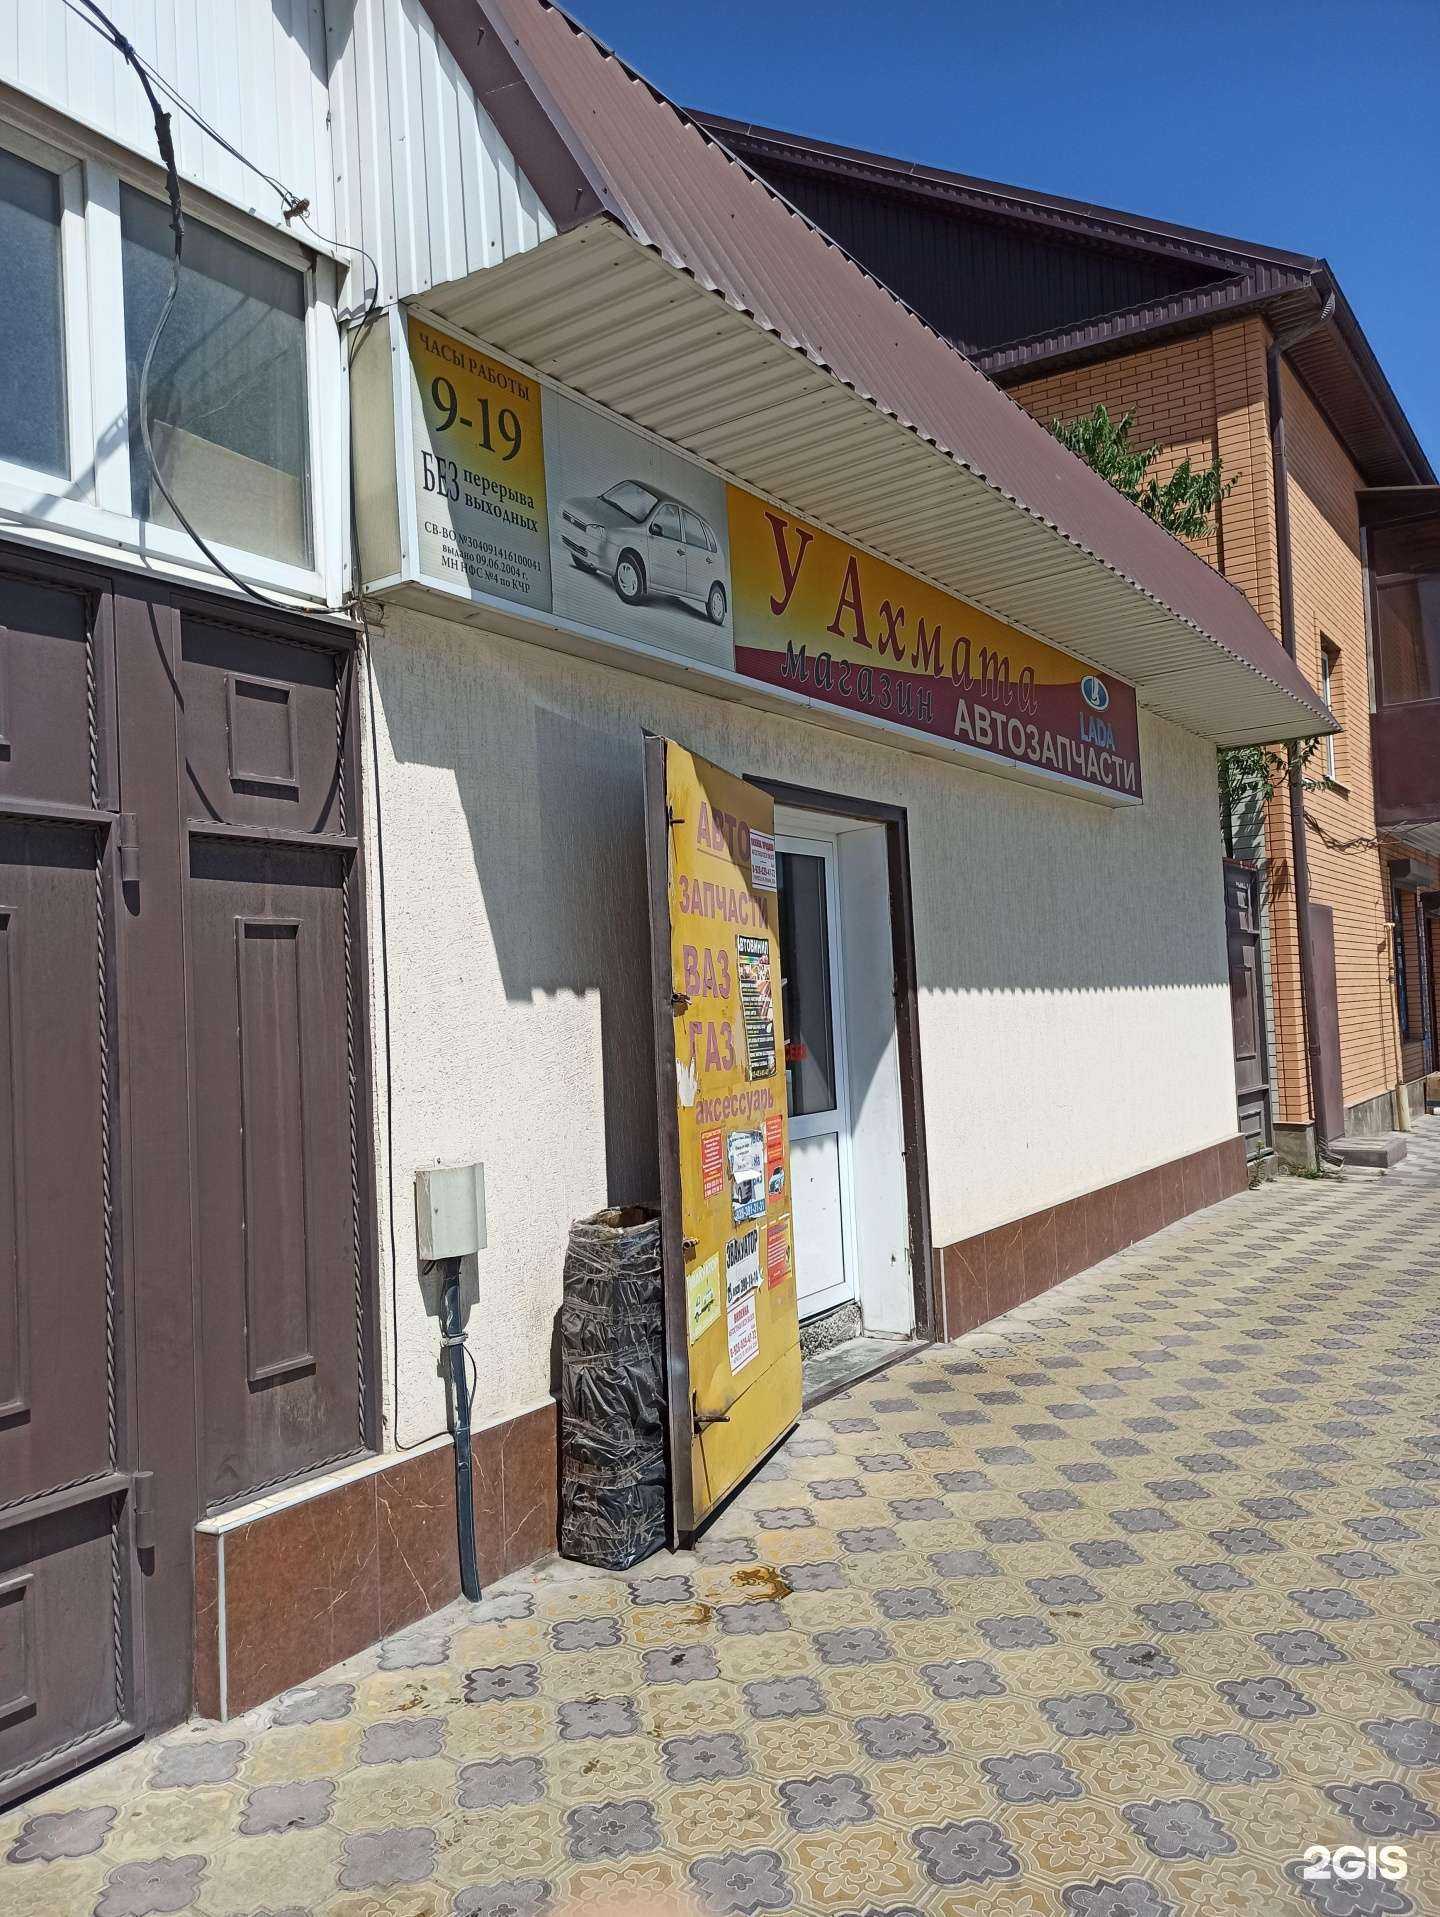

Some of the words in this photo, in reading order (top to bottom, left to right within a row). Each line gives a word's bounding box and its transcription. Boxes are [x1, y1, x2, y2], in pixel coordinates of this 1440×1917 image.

[419, 332, 465, 368] ЧАСЫ
[469, 359, 530, 401] РАБОТЫ
[431, 376, 522, 462] 9-19
[421, 450, 460, 502] БЕЗ
[463, 469, 535, 509] перерыва
[424, 521, 457, 541] СВ-ВО
[465, 494, 538, 533] выходных
[442, 544, 475, 562] выдано
[476, 553, 520, 577] 09.06.2004
[765, 511, 814, 616] У
[826, 555, 1037, 716] Ахмата
[781, 639, 933, 723] магазин
[954, 699, 1136, 791] АВТОЗАПЧАСТИ
[1080, 711, 1115, 750] LADA
[697, 801, 751, 862] АВТО
[679, 875, 769, 929] ЗАПЧАСТИ
[683, 944, 731, 999] ВАЗ
[688, 1021, 735, 1073] ГАЗ
